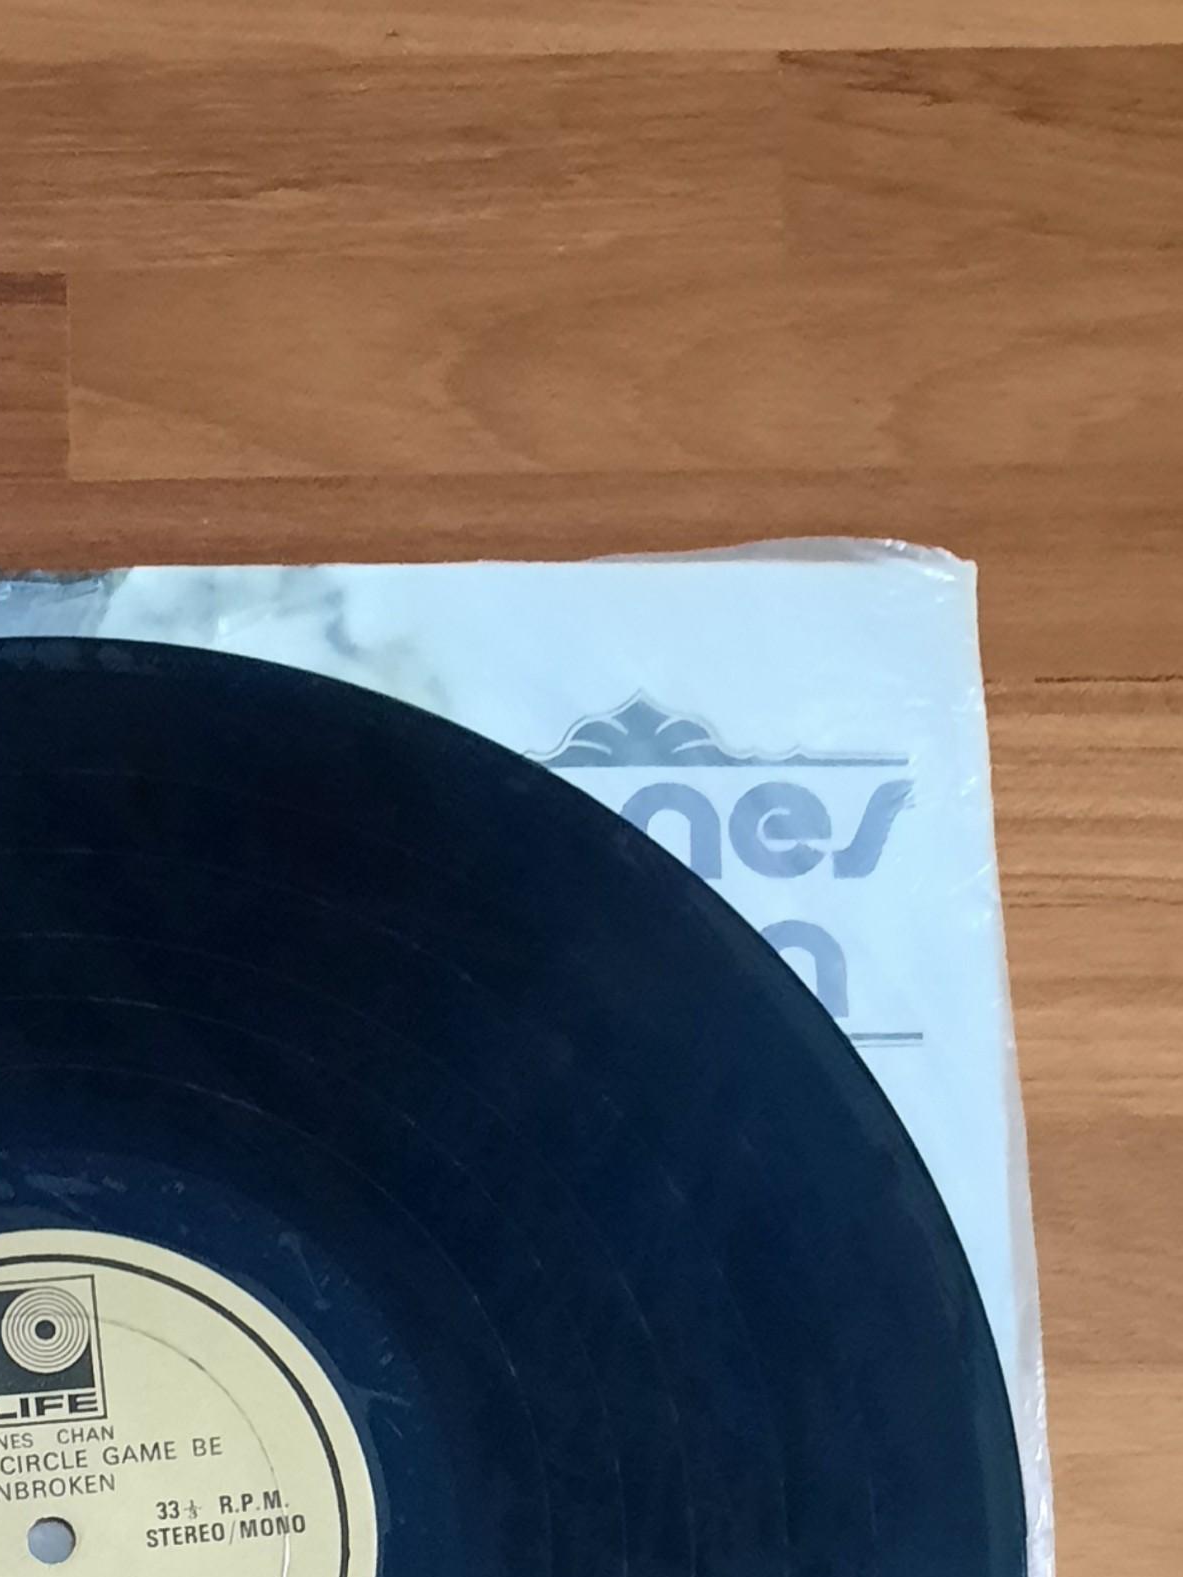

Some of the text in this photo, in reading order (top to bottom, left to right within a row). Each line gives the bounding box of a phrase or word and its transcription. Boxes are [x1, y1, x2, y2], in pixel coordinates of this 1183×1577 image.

[619, 779, 916, 879] nes
[56, 1425, 115, 1444] CHAN
[0, 1451, 89, 1475] CIRCLE
[103, 1441, 177, 1466] GAME
[192, 1436, 223, 1457] BE
[219, 1490, 290, 1514] R.P.M.
[146, 1514, 306, 1548] STEREO/MONO
